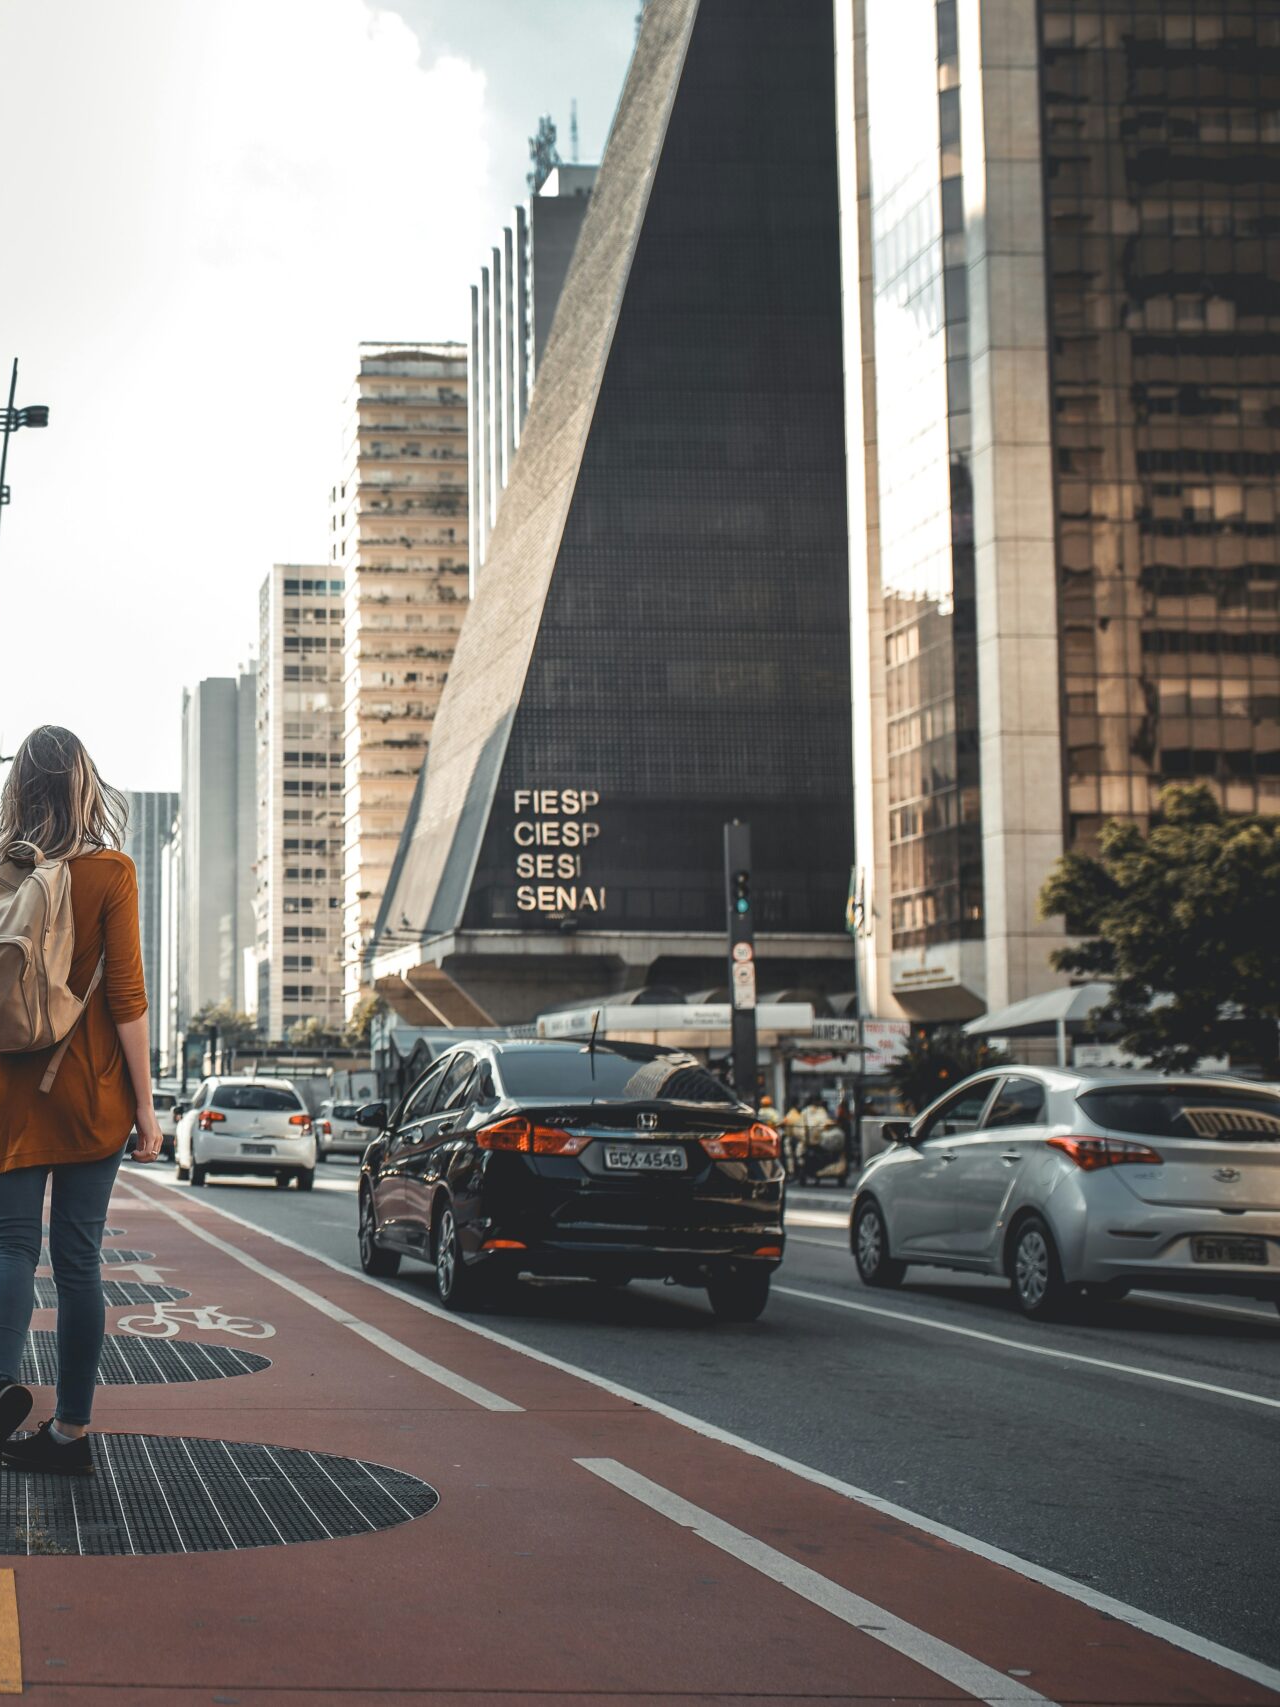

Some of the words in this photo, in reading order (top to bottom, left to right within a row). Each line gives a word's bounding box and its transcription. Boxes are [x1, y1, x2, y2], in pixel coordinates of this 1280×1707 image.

[514, 789, 600, 815] FIESP
[514, 821, 600, 847] CIESP
[516, 853, 582, 879] SESI
[516, 885, 606, 912] SENAI
